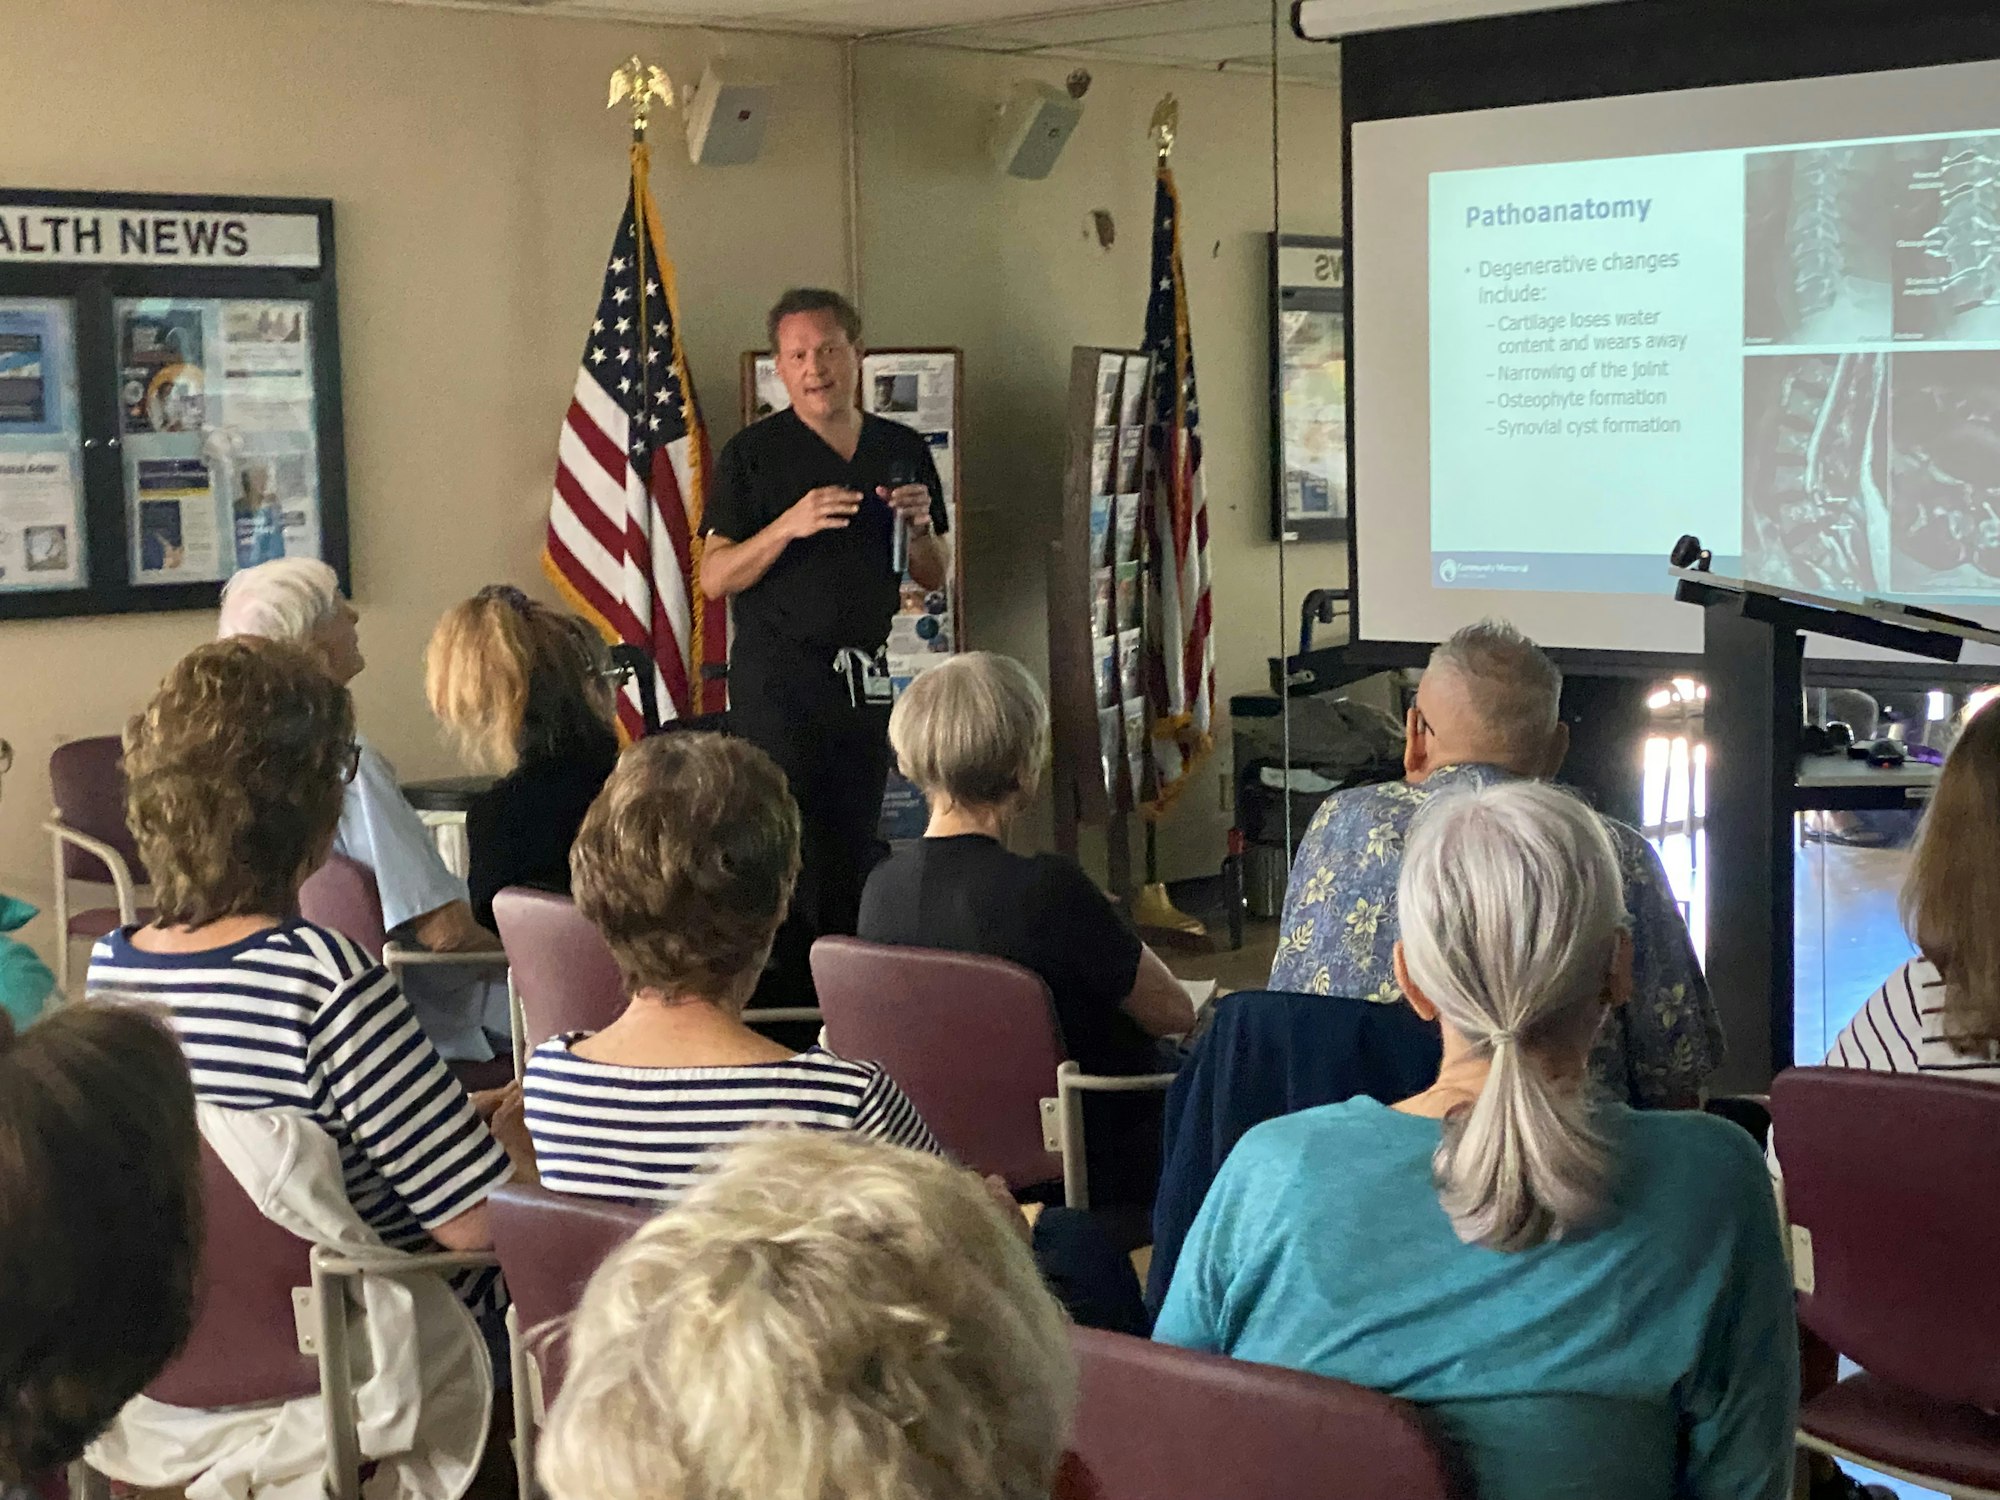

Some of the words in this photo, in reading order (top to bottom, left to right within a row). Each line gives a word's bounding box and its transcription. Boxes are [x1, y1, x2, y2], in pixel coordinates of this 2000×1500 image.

[1466, 198, 1653, 228] Pathoanatomy
[119, 218, 248, 256] NEWS
[1479, 255, 1597, 281] Degenerative
[1602, 252, 1680, 274] changes
[1479, 283, 1547, 304] include:
[1498, 314, 1566, 332] Cartilage
[1570, 312, 1611, 328] loses
[1615, 309, 1661, 326] water
[1498, 336, 1555, 354] content
[1559, 335, 1589, 351] and
[1593, 335, 1642, 350] wears
[1646, 333, 1688, 351] away
[1498, 364, 1576, 382] Narrowing
[1580, 361, 1598, 378] of
[1601, 361, 1628, 378] the
[1631, 359, 1669, 380] joint
[1498, 391, 1585, 410] Osteophyte
[1589, 389, 1668, 406] formation
[1498, 418, 1562, 438] Synovial
[1566, 418, 1599, 437] cyst
[1603, 416, 1682, 434] formation
